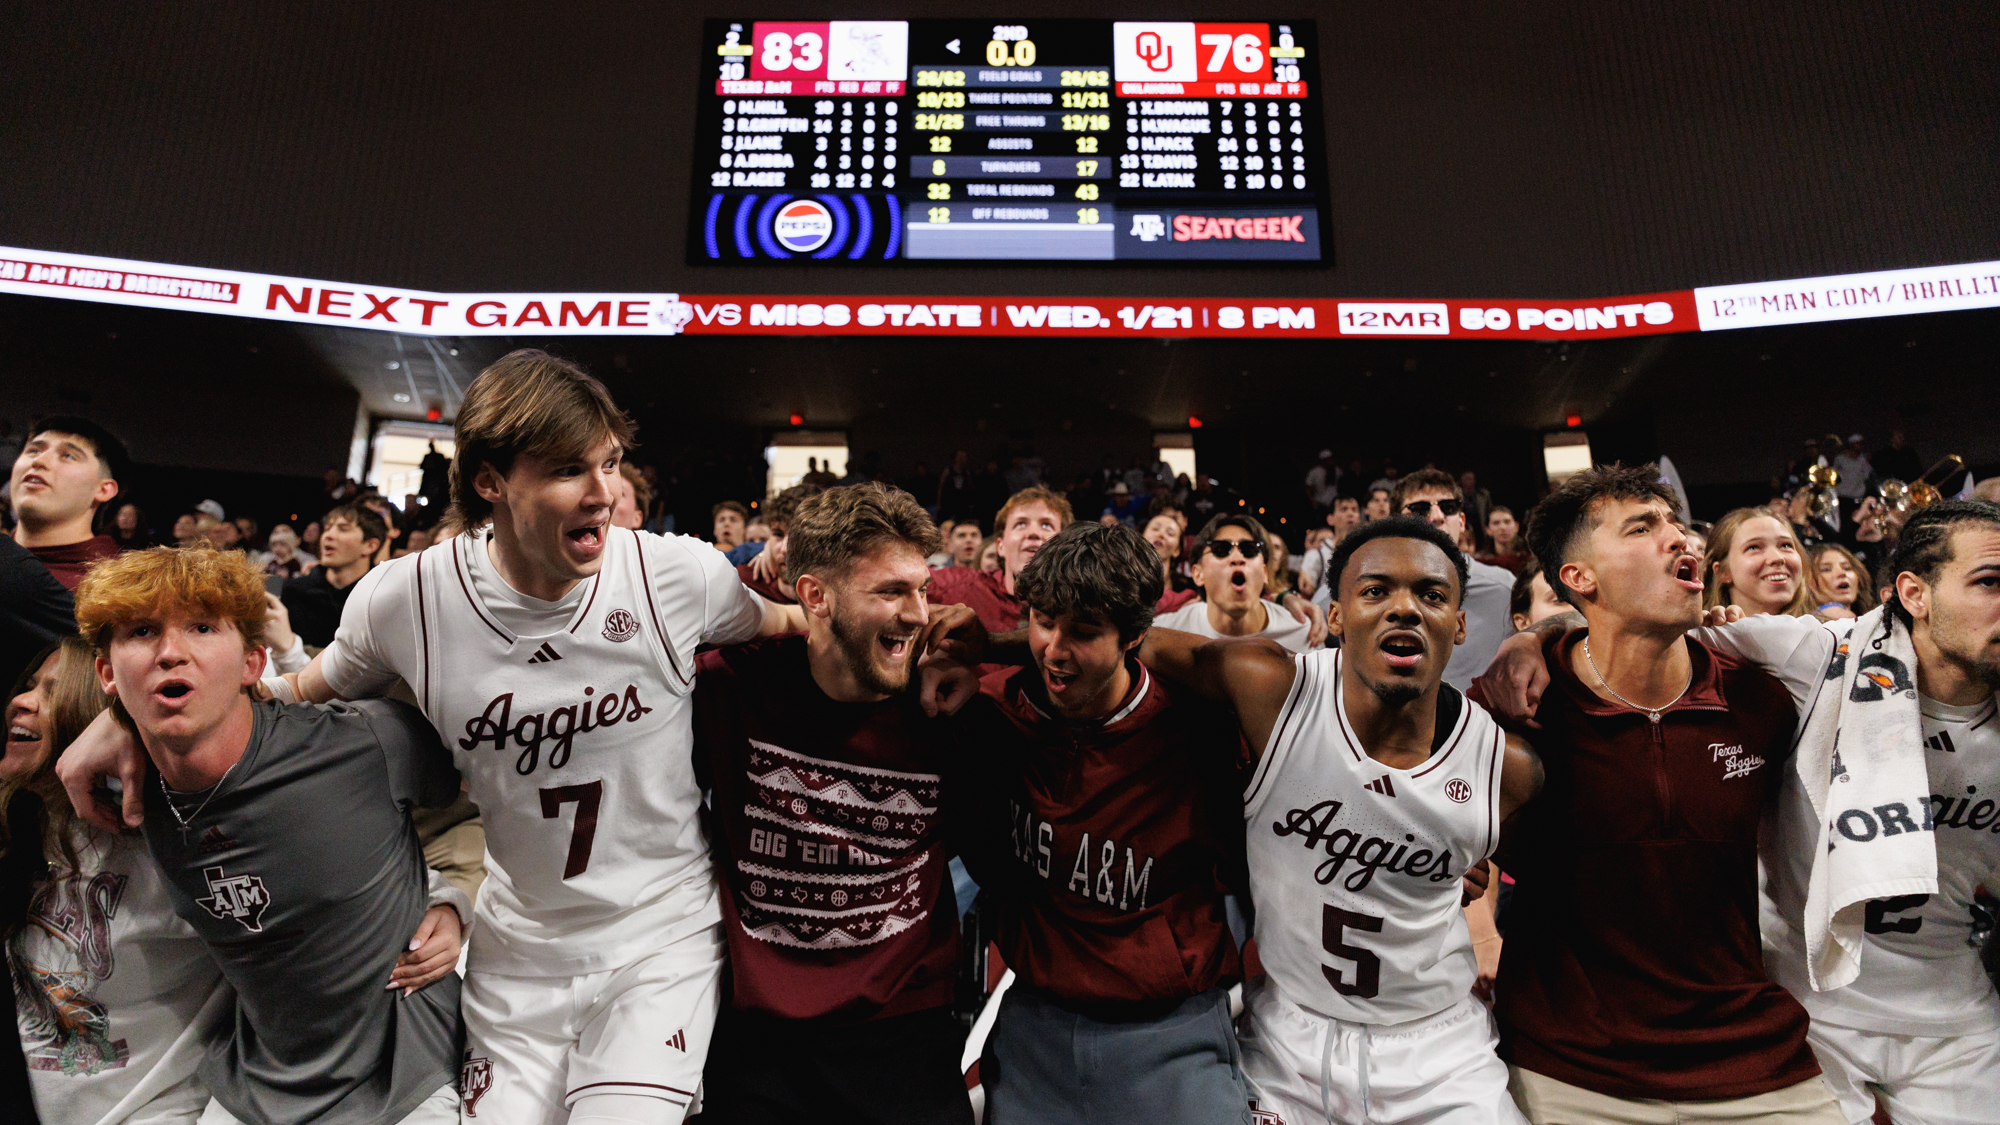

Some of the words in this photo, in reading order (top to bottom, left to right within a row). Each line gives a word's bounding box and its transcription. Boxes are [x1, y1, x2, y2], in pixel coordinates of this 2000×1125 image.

[725, 32, 740, 48] 2
[993, 25, 1028, 41] 2ND
[1279, 34, 1294, 50] 0
[761, 32, 823, 71] 83
[986, 40, 1036, 66] 0.0
[1201, 34, 1263, 73] 76
[719, 63, 745, 80] 10
[917, 71, 965, 87] 26/62
[1061, 71, 1109, 87] 26/62
[1274, 65, 1300, 82] 10
[722, 81, 764, 93] TEXAS
[1122, 83, 1184, 94] OKLAHOMA
[917, 92, 965, 109] 10/33
[1061, 92, 1109, 109] 11/31
[1127, 101, 1138, 115] 1
[1140, 101, 1209, 115] X.BROWN
[1220, 101, 1233, 117] 7
[1244, 101, 1256, 117] 3
[1267, 101, 1279, 117] 2
[1289, 101, 1301, 117] 2
[722, 118, 735, 132] 3
[813, 119, 833, 133] 14
[840, 119, 852, 133] 2
[885, 119, 897, 133] 3
[915, 114, 964, 130] 21/25
[1062, 115, 1110, 131] 13/16
[1290, 120, 1303, 135] 4
[816, 136, 828, 151] 3
[841, 136, 851, 151] 1
[885, 136, 897, 151] 3
[929, 136, 951, 152] 12
[1076, 136, 1098, 153] 12
[1218, 138, 1238, 152] 24
[1291, 138, 1304, 152] 4
[814, 154, 827, 169] 4
[980, 161, 1040, 173] TURNOVERS
[1076, 160, 1098, 176] 17
[1120, 154, 1139, 169] 13
[1141, 154, 1197, 169] T.DAVIS
[1219, 156, 1239, 170] 12
[1244, 156, 1263, 170] 10
[1271, 156, 1283, 170] 1
[1293, 156, 1305, 170] 2
[711, 172, 731, 187] 12
[835, 173, 855, 188] 12
[860, 173, 873, 188] 2
[882, 173, 895, 188] 4
[1119, 173, 1140, 188] 22
[1224, 174, 1236, 189] 2
[1245, 174, 1265, 189] 10
[1270, 174, 1283, 189] 0
[1293, 174, 1306, 189] 0
[928, 183, 951, 200] 32
[1075, 184, 1099, 200] 43
[928, 207, 950, 223] 12
[1077, 208, 1099, 224] 16
[1173, 215, 1305, 242] SEATGEEK
[67, 269, 122, 290] MEN'S
[123, 273, 233, 301] BASKETBALL
[266, 284, 449, 326] NEXT
[465, 301, 650, 327] GAME
[694, 304, 742, 326] VS
[750, 304, 851, 326] MISS
[857, 304, 982, 327] STATE
[1006, 305, 1110, 328] WED.
[1117, 305, 1192, 329] 1/21
[1217, 306, 1245, 328] 8
[1252, 307, 1315, 329] PM
[1343, 312, 1441, 327] 12MR
[1459, 308, 1511, 331] 50
[1517, 302, 1674, 331] POINTS
[608, 611, 631, 632] SEC
[458, 684, 653, 776] Aggies
[1707, 743, 1743, 763] Texas
[1448, 781, 1470, 801] SEC
[539, 780, 603, 881] 7
[750, 828, 787, 858] GIG
[1272, 800, 1453, 892] Aggies
[1069, 832, 1153, 911] A&M
[1321, 903, 1384, 1000] 5
